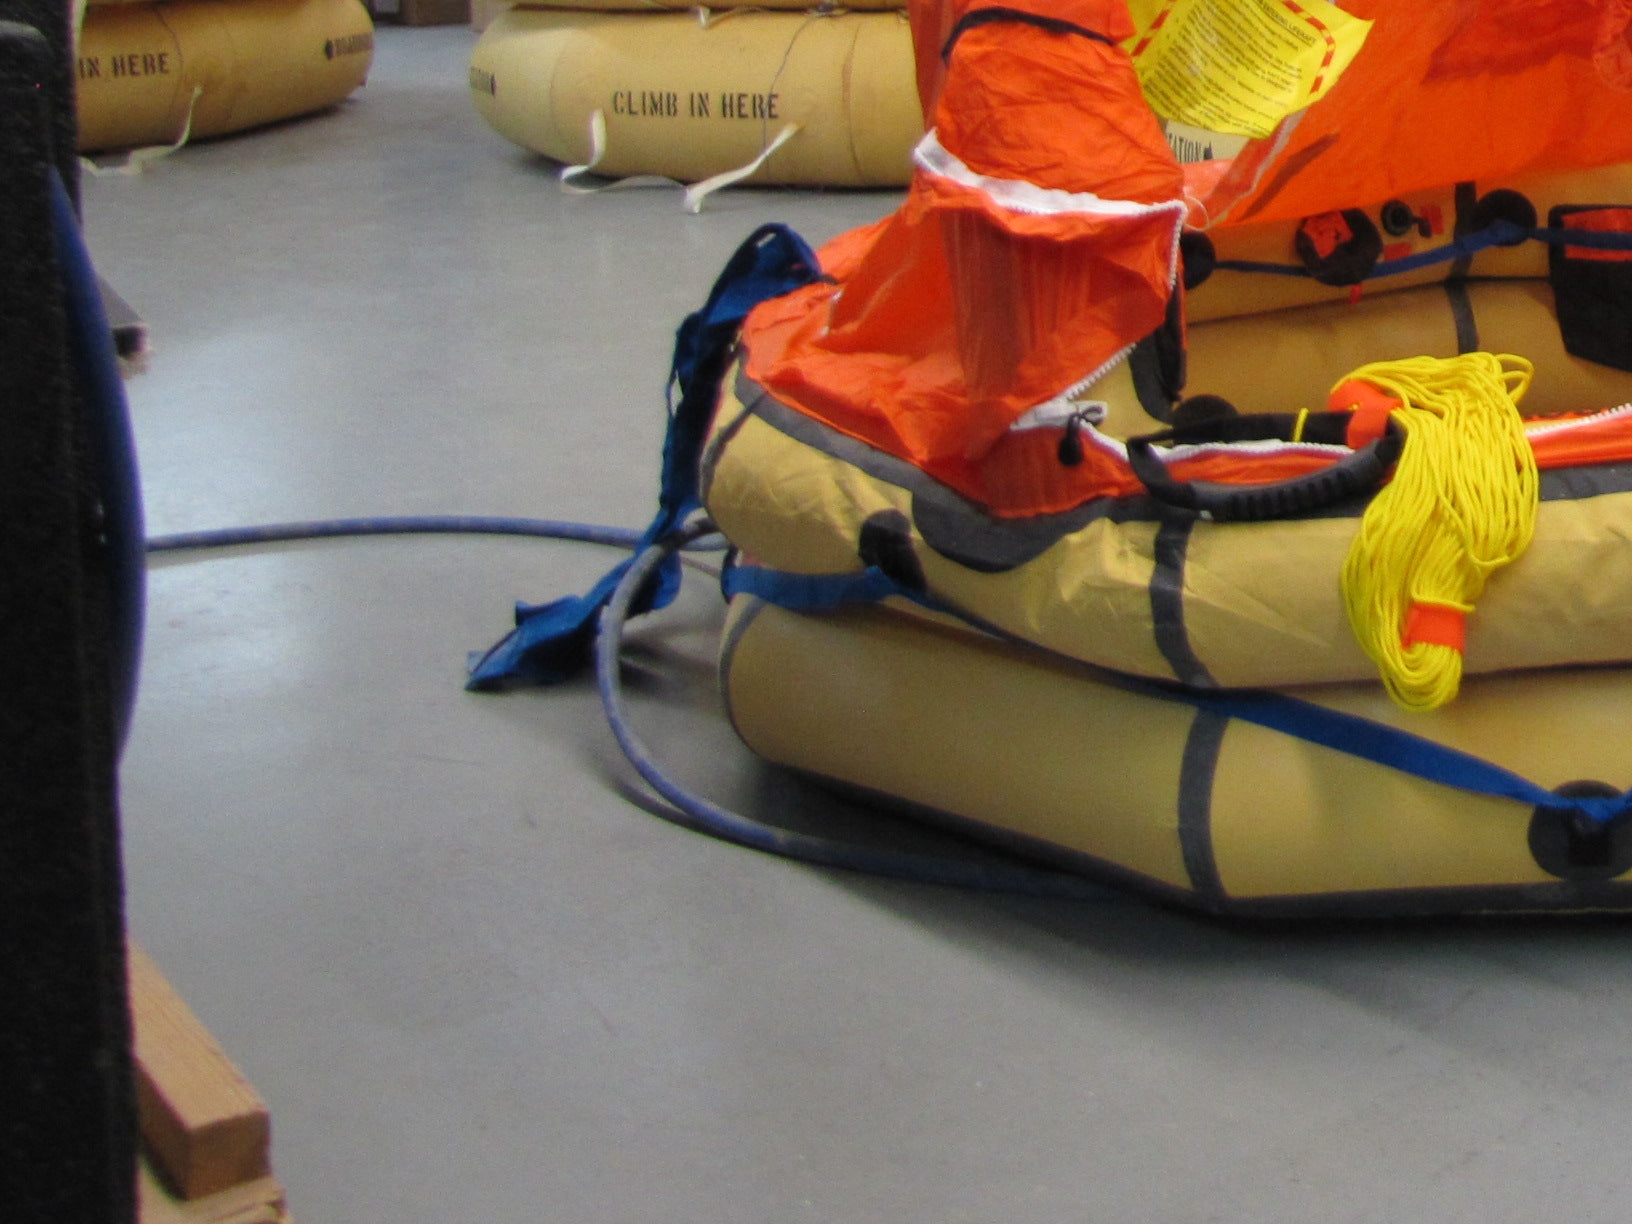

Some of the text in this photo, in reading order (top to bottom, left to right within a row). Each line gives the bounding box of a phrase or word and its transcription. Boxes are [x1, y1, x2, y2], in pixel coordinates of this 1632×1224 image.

[80, 52, 170, 79] IN HERE
[613, 90, 779, 119] CLIMB IN HERE
